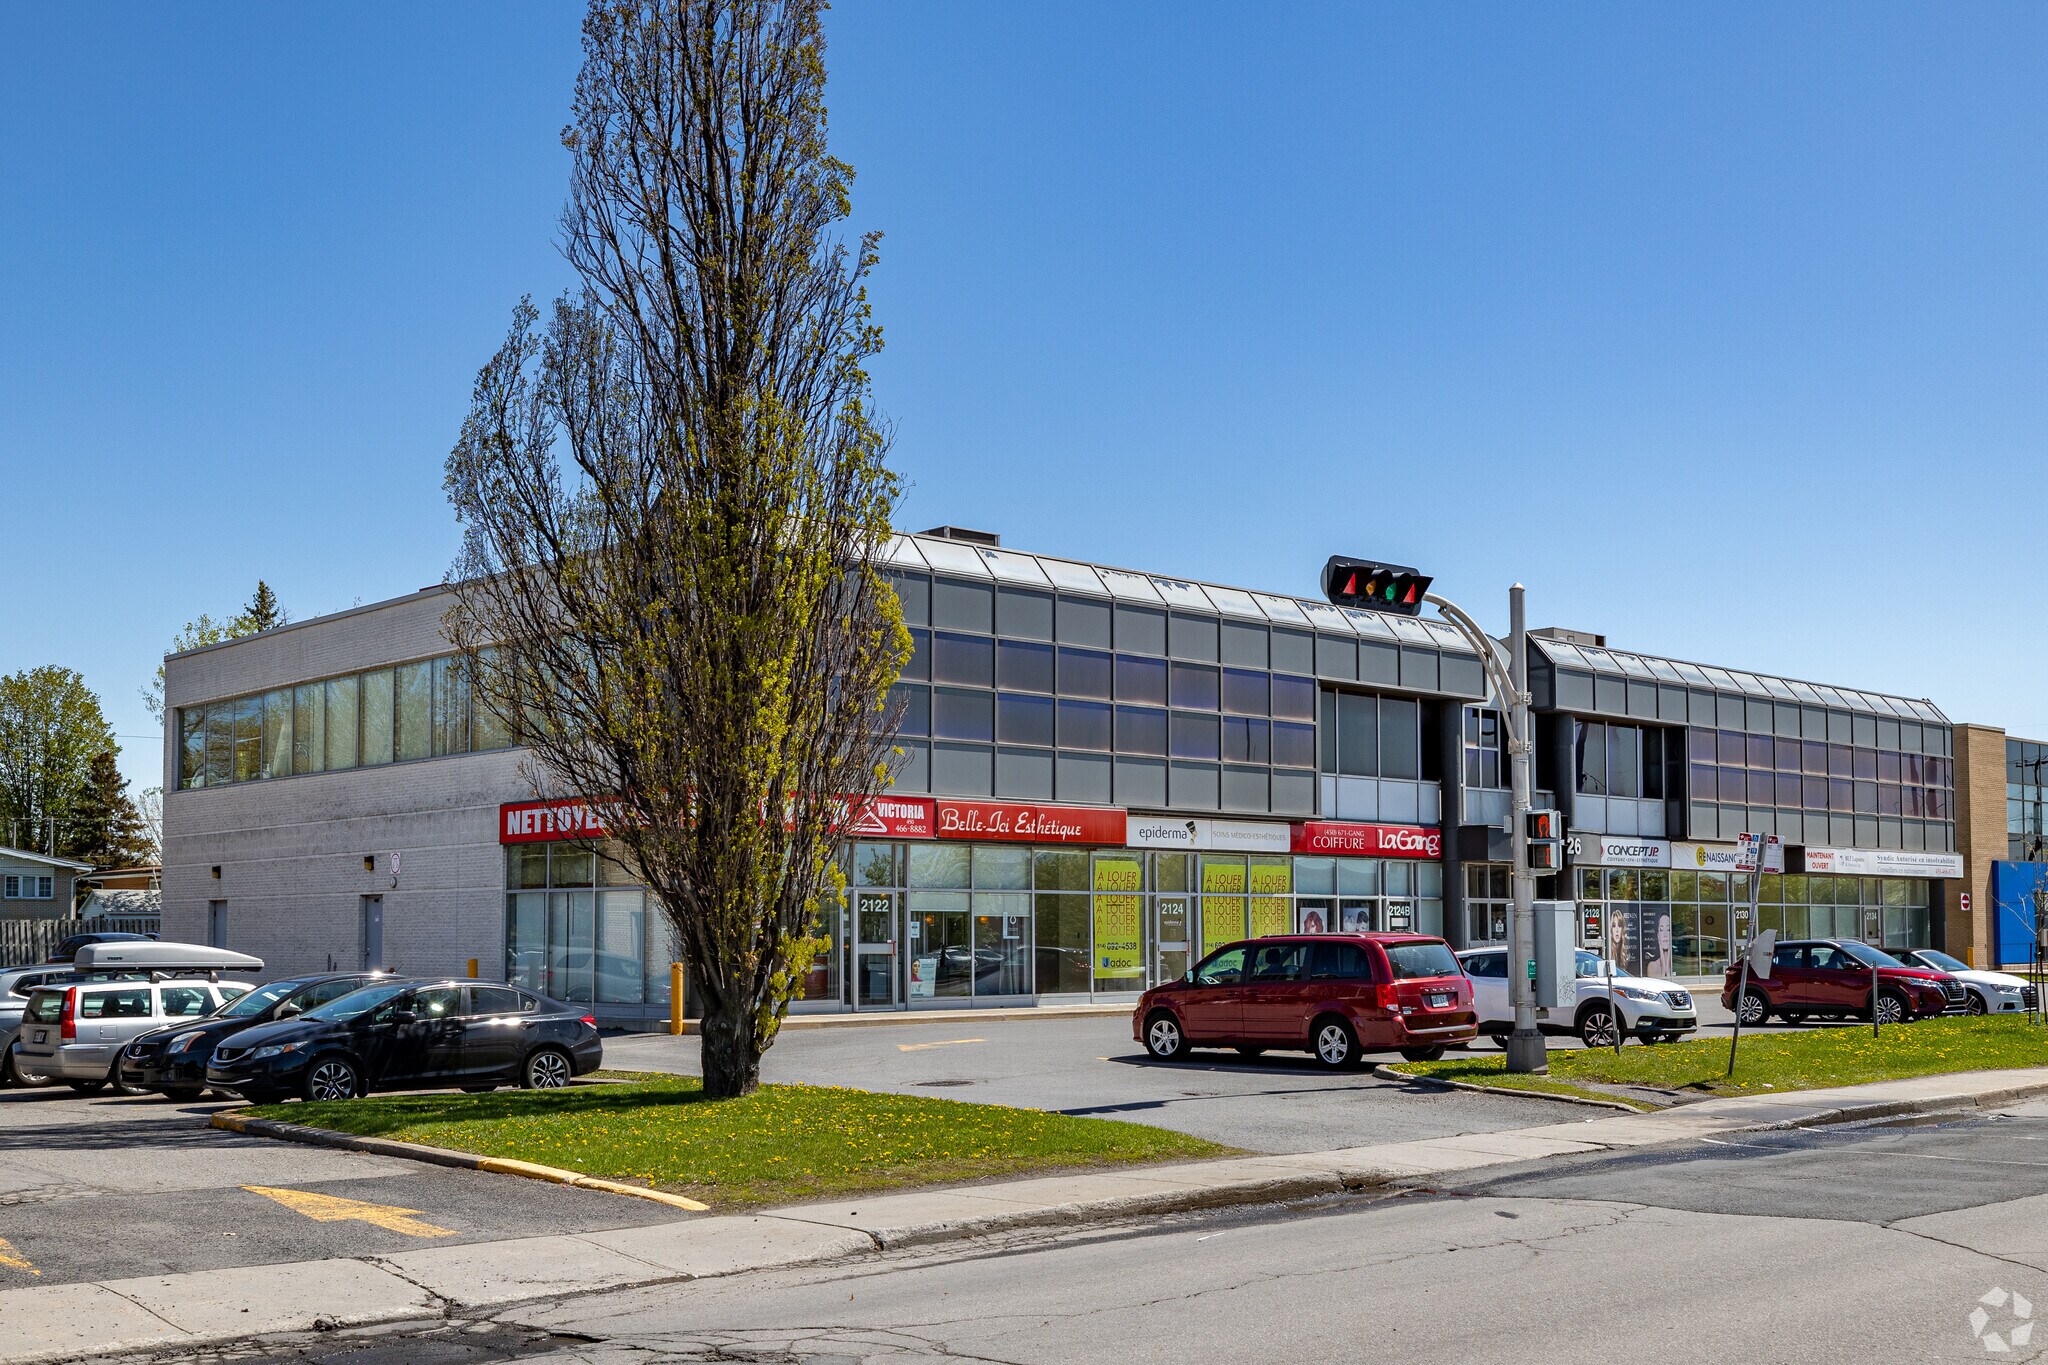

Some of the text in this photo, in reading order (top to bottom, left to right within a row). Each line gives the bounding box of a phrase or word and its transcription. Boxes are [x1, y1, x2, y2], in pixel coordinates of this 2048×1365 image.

[877, 802, 924, 820] VICTORIA
[507, 804, 627, 835] NETTOYE
[941, 808, 1082, 840] Belle-Ici Esthétique
[895, 824, 927, 834] 466-8882
[1139, 826, 1187, 842] epiderma
[1337, 829, 1365, 837] 671-GANG
[1213, 830, 1286, 841] SOINS MÉDICO-ESTHÉTIQUES
[1313, 836, 1365, 850] COIFFURE
[1108, 871, 1136, 882] LOUER
[1215, 874, 1241, 885] LOUER
[1261, 875, 1286, 885] LOUER
[1107, 882, 1135, 891] LOUER
[1214, 885, 1240, 894] LOUER
[1260, 885, 1285, 894] LOUER
[1107, 895, 1135, 903] LOUER
[1214, 896, 1240, 905] LOUER
[1260, 897, 1285, 905] LOUER
[861, 899, 889, 912] 2122
[1107, 904, 1135, 914] LOUER
[1162, 903, 1183, 914] 2124
[1214, 906, 1240, 915] LOUER
[1260, 906, 1285, 915] LOUER
[1389, 906, 1410, 916] 2124B
[1585, 909, 1599, 917] 2128
[1736, 911, 1748, 919] 2130
[1107, 915, 1135, 925] LOUER
[1214, 916, 1240, 925] LOUER
[1260, 916, 1285, 925] LOUER
[1107, 926, 1135, 936] LOUER
[1214, 926, 1240, 936] LOUER
[1260, 926, 1285, 935] LOUER
[1107, 942, 1137, 950] 692-4538
